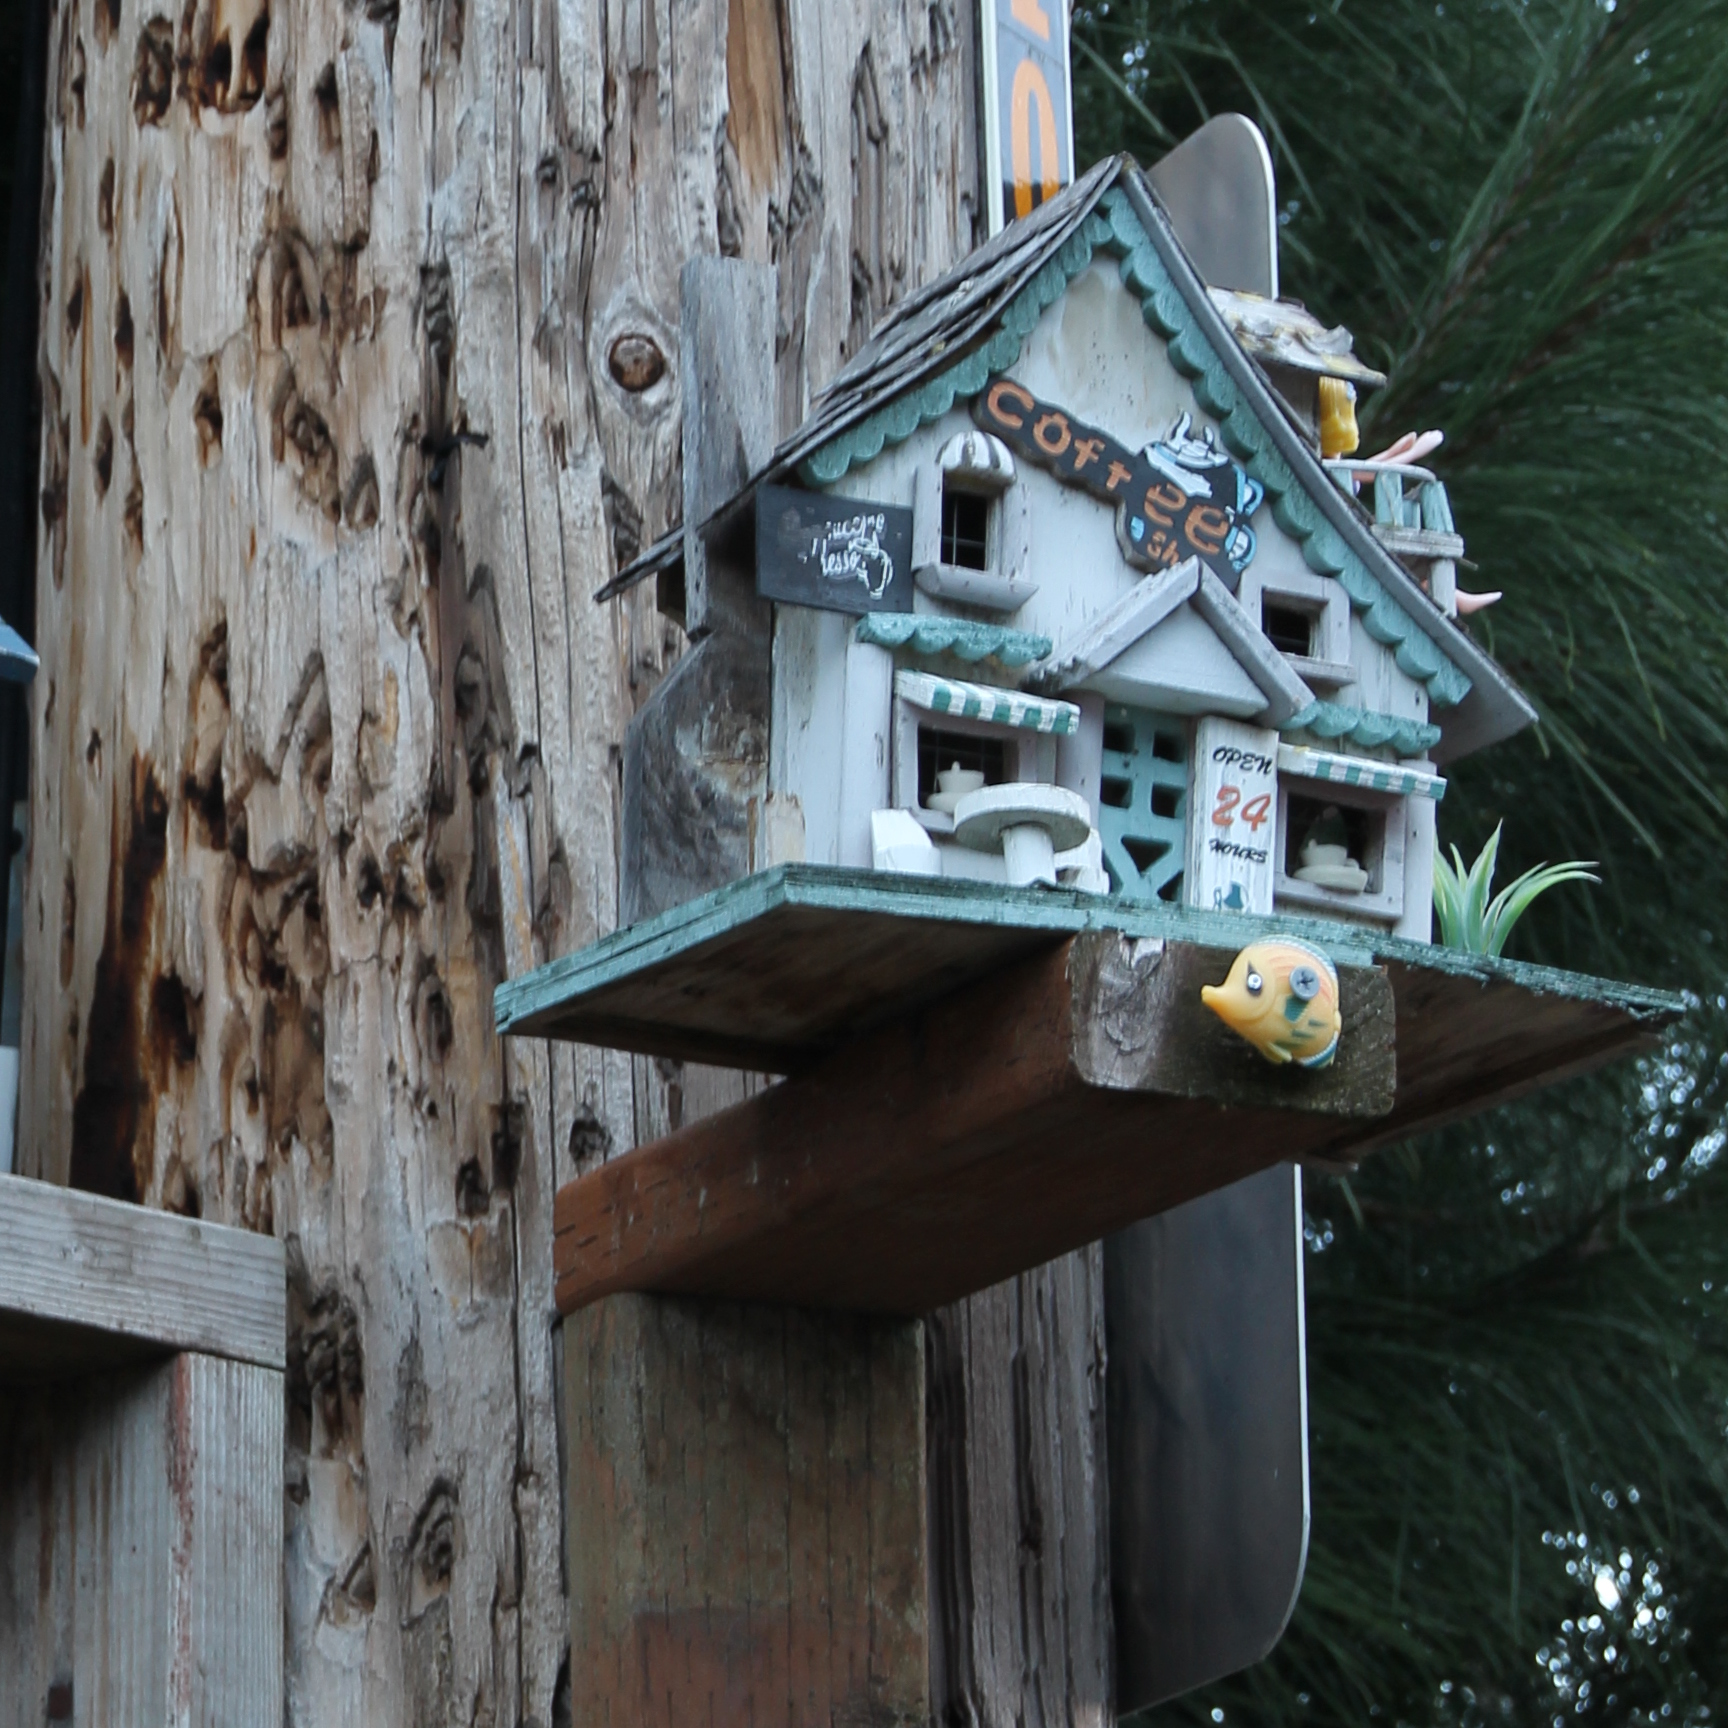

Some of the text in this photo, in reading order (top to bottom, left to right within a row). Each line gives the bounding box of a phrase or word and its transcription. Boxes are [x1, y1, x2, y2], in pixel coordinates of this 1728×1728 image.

[1212, 745, 1273, 776] OPEN
[1211, 784, 1272, 833] 24
[1208, 837, 1268, 865] HOURS
